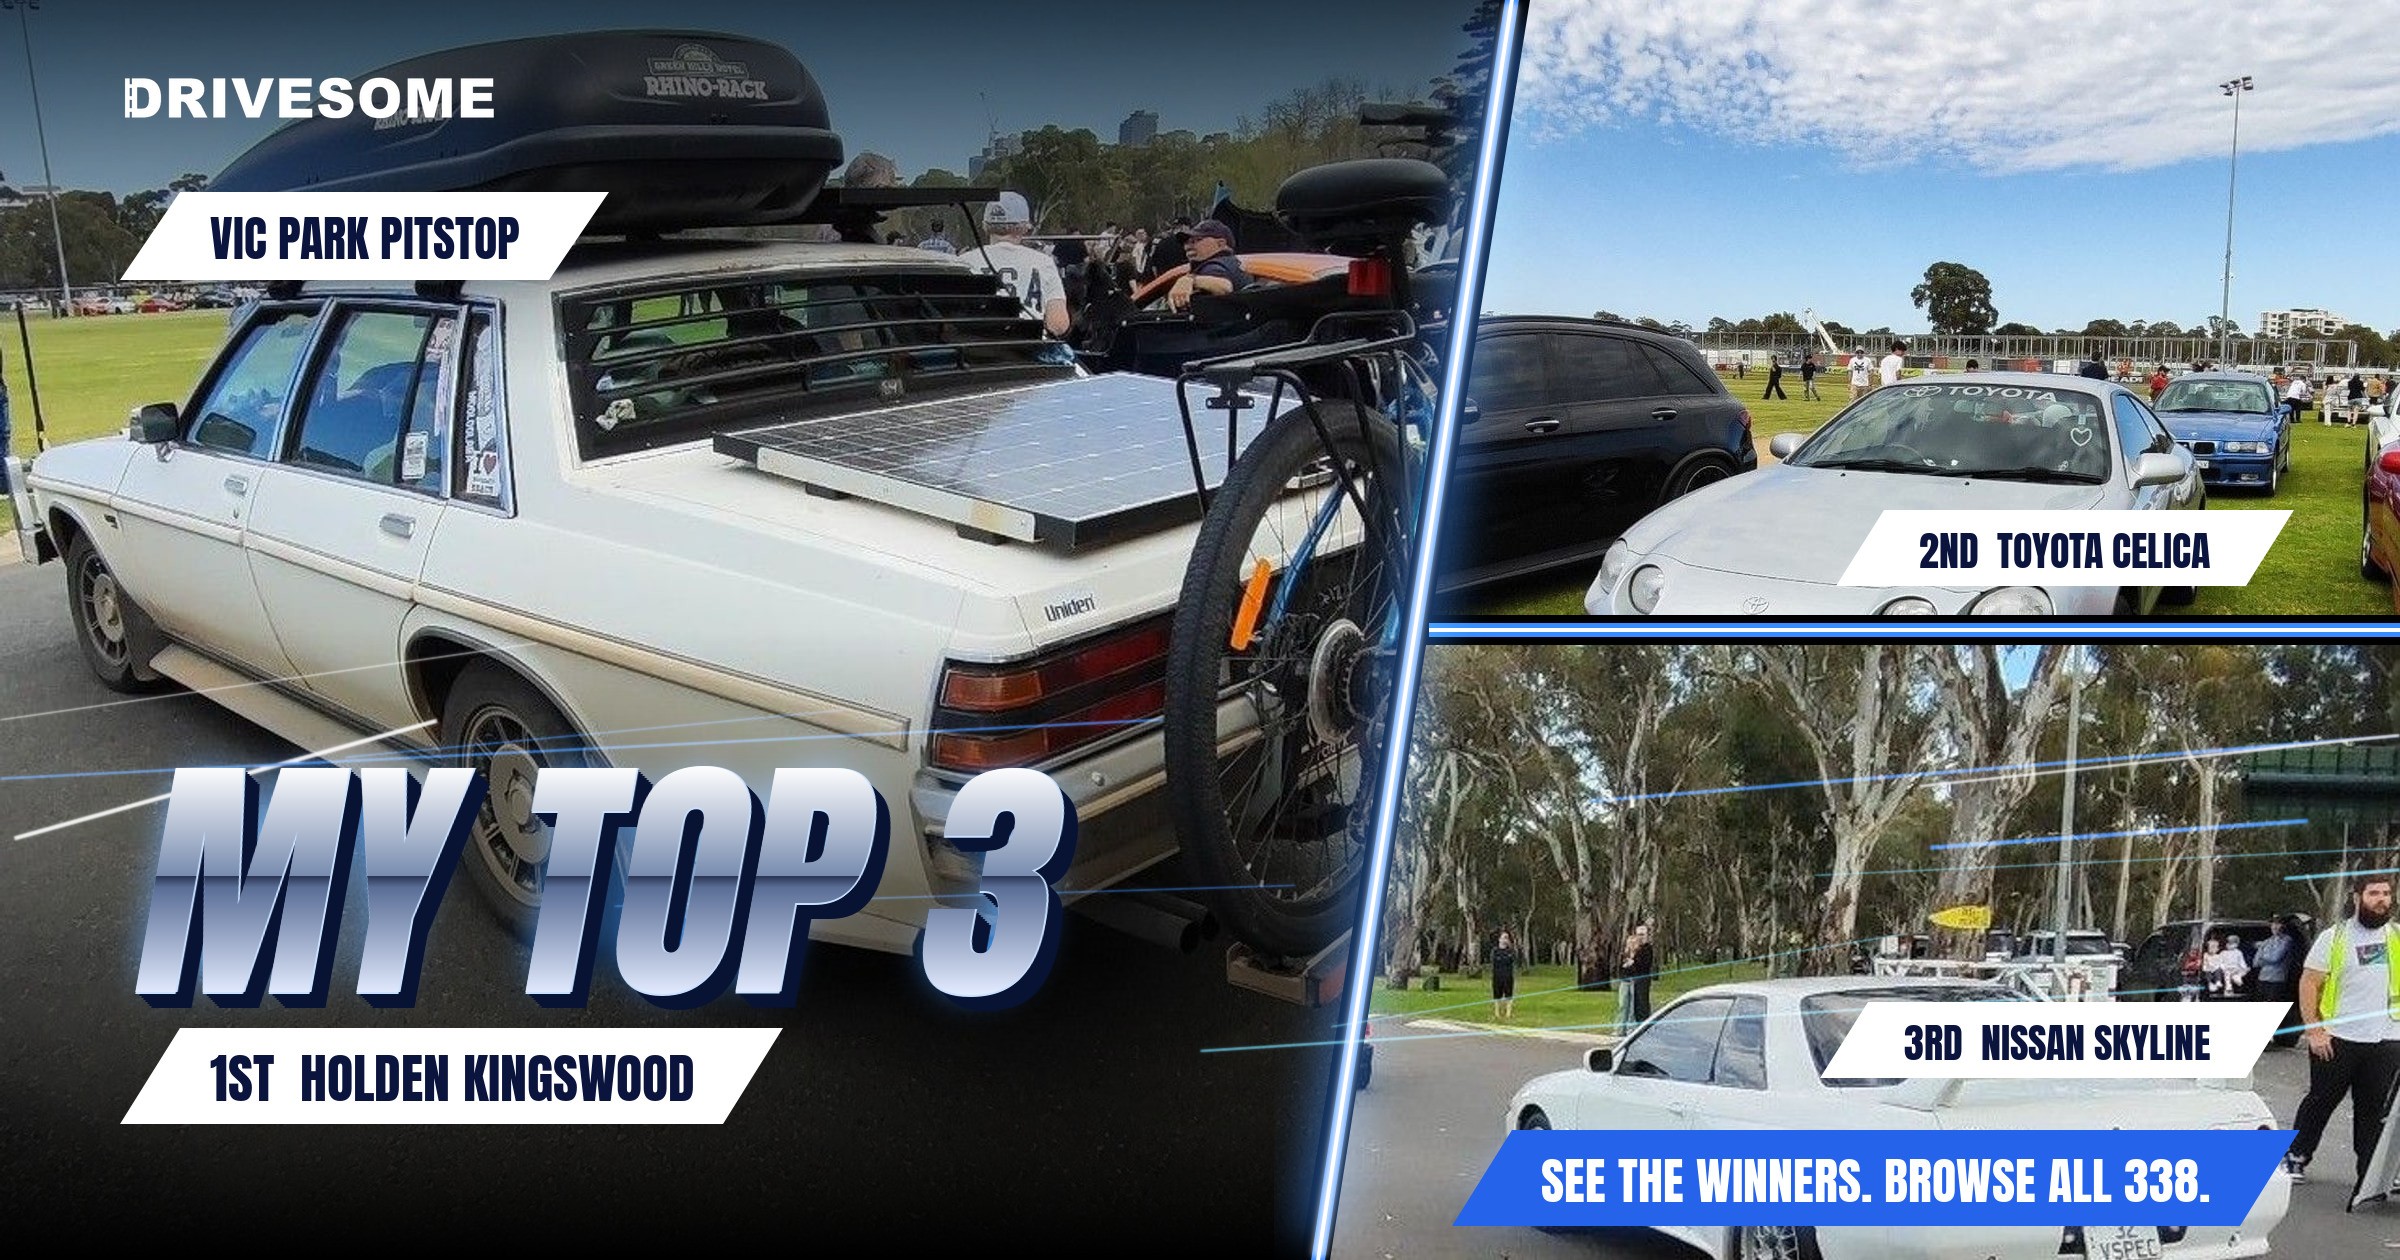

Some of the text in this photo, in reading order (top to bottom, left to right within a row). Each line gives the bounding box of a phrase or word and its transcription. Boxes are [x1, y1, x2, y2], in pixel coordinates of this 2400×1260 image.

[643, 76, 769, 99] RHINO-RACK
[981, 267, 1042, 312] SA
[1949, 386, 2057, 402] TOYOTA
[1044, 594, 1096, 621] Uniden
[2100, 1239, 2157, 1260] VSPEC
